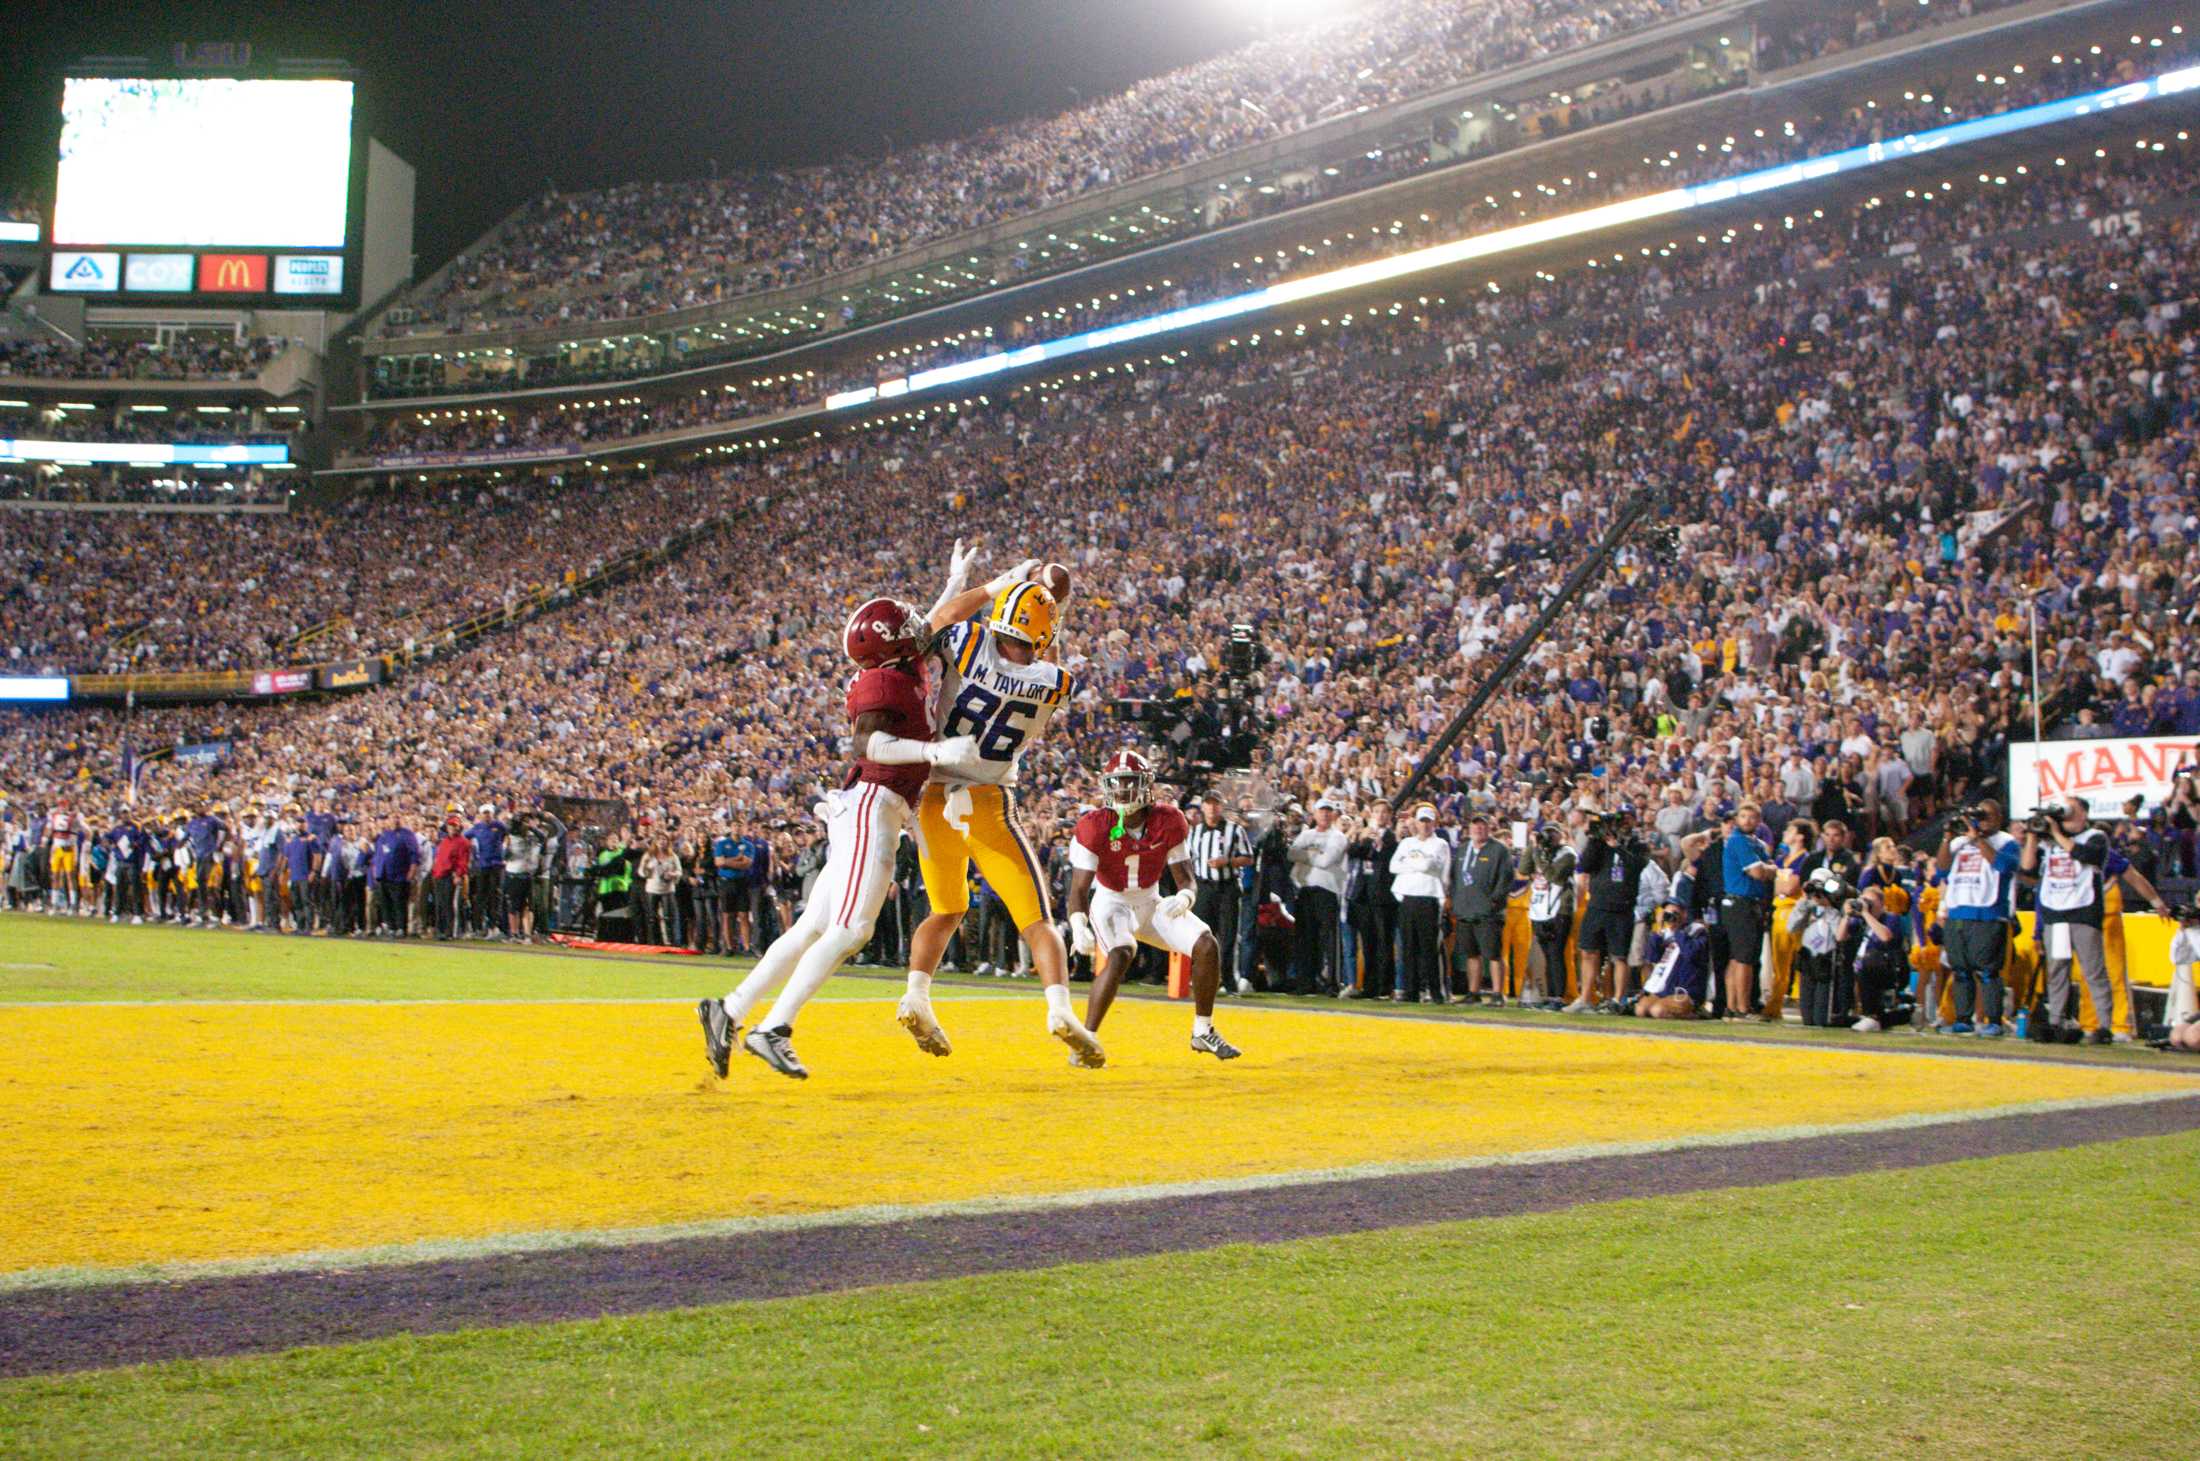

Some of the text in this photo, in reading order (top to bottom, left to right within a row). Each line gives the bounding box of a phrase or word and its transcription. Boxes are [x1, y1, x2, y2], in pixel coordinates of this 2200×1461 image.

[174, 41, 251, 67] LSU
[128, 260, 188, 283] COX
[872, 621, 894, 641] 9
[972, 663, 1047, 700] M. TAYLOR
[943, 683, 1038, 761] 86
[1123, 854, 1142, 893] 1
